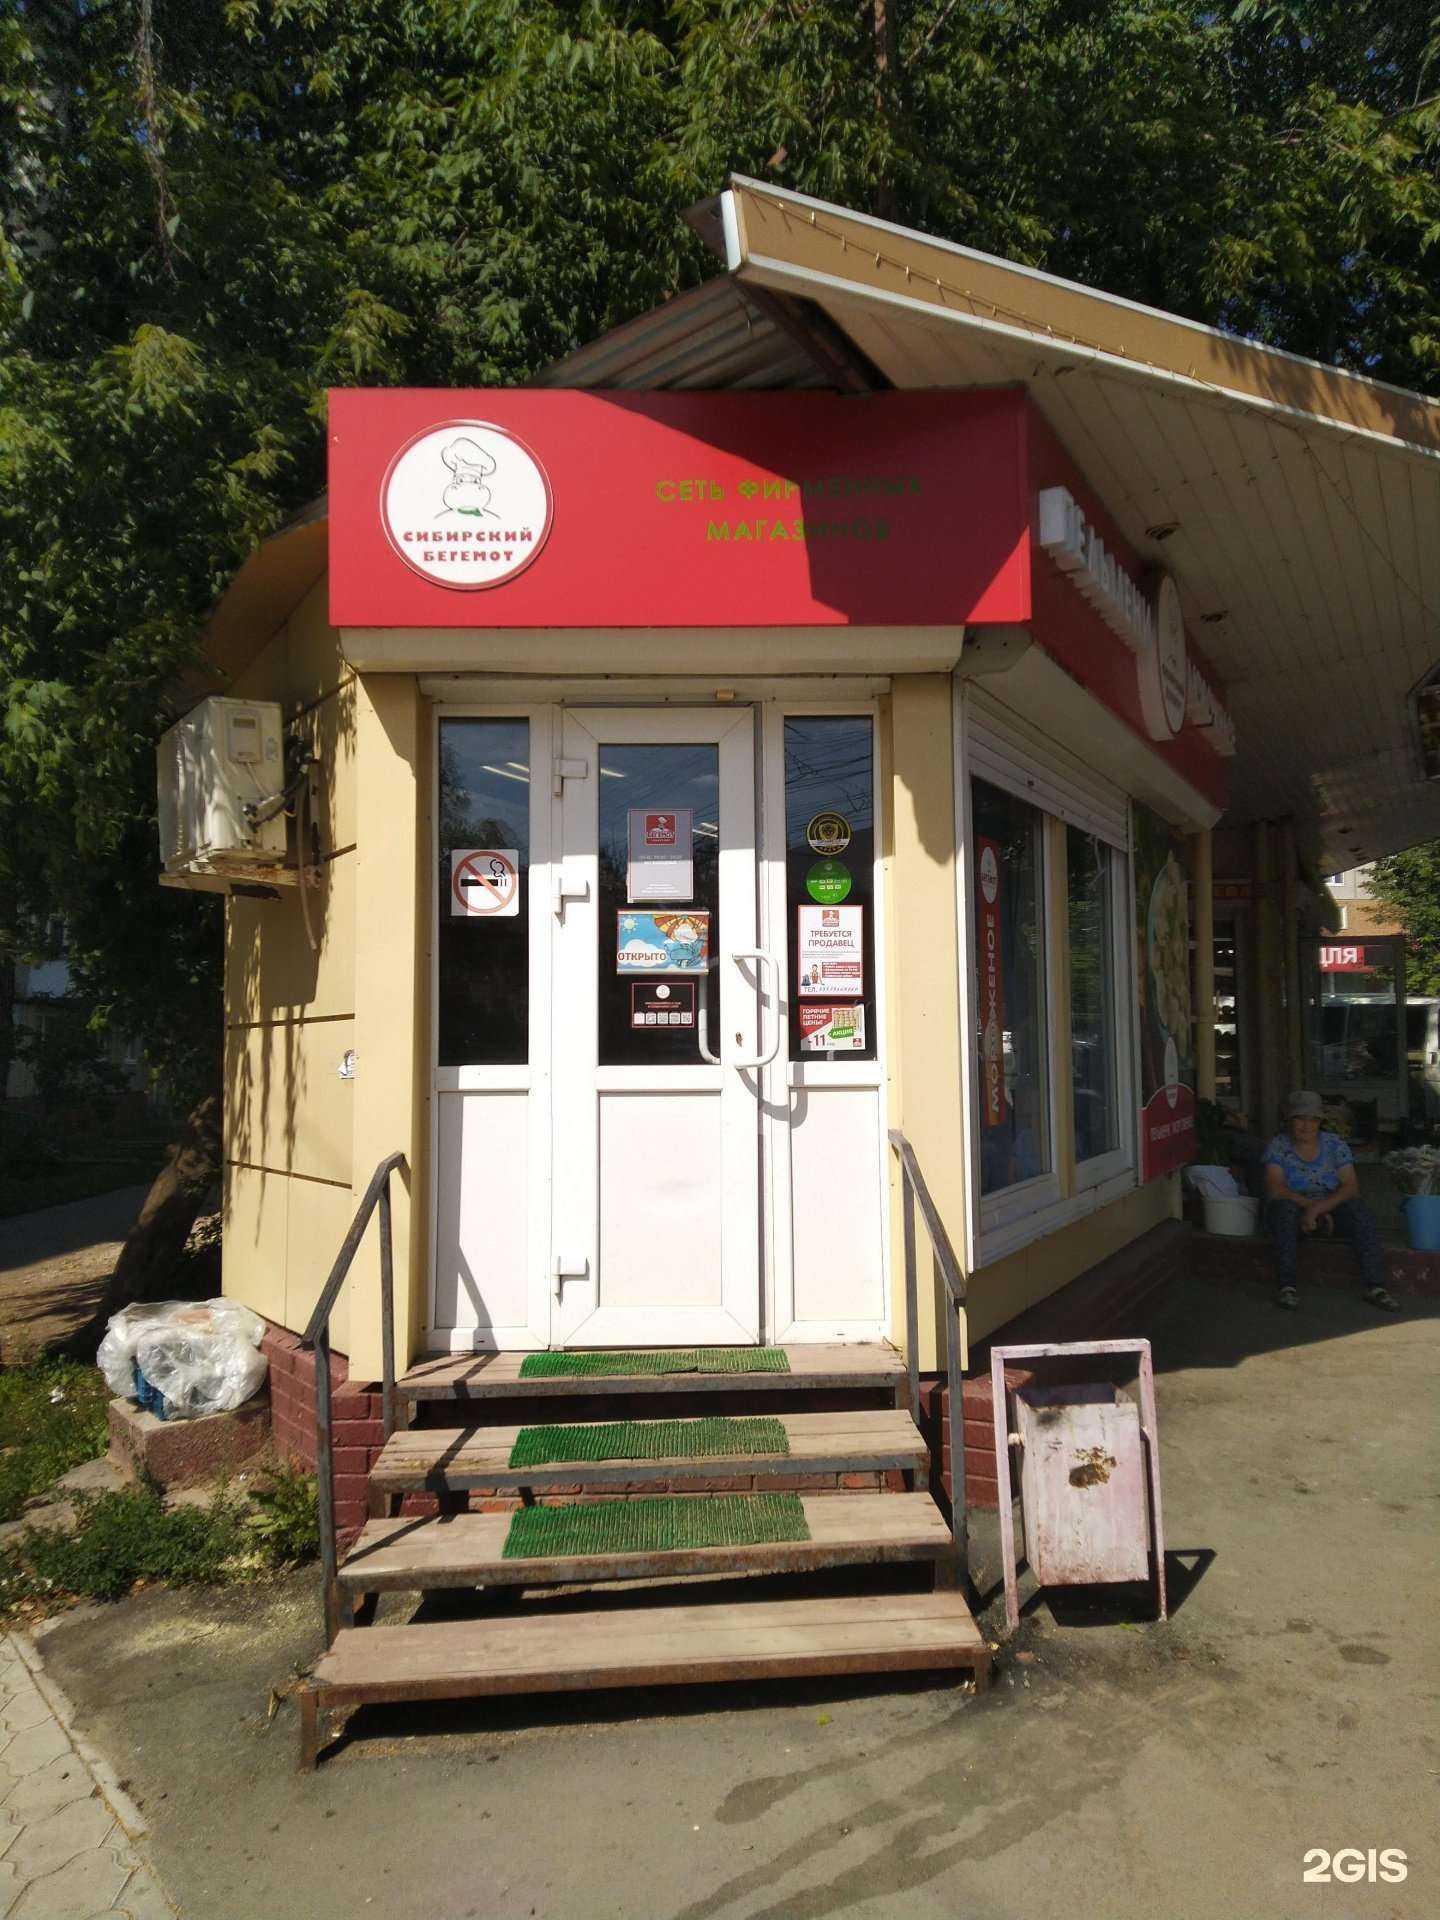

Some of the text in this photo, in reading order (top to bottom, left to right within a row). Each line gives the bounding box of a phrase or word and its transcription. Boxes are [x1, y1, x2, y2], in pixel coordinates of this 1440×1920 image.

[655, 474, 923, 503] СЕТЬ ФИРМЕННЫХ
[403, 526, 533, 542] СИБИРСКИЙ
[704, 517, 892, 545] МАГАЗИНОВ
[423, 551, 514, 562] БЕГЕМОТ
[810, 930, 852, 938] ТРЕБУЕТСЯ
[808, 939, 855, 948] ПРОДАВЕЦ
[617, 952, 667, 961] ОТКРЫТО
